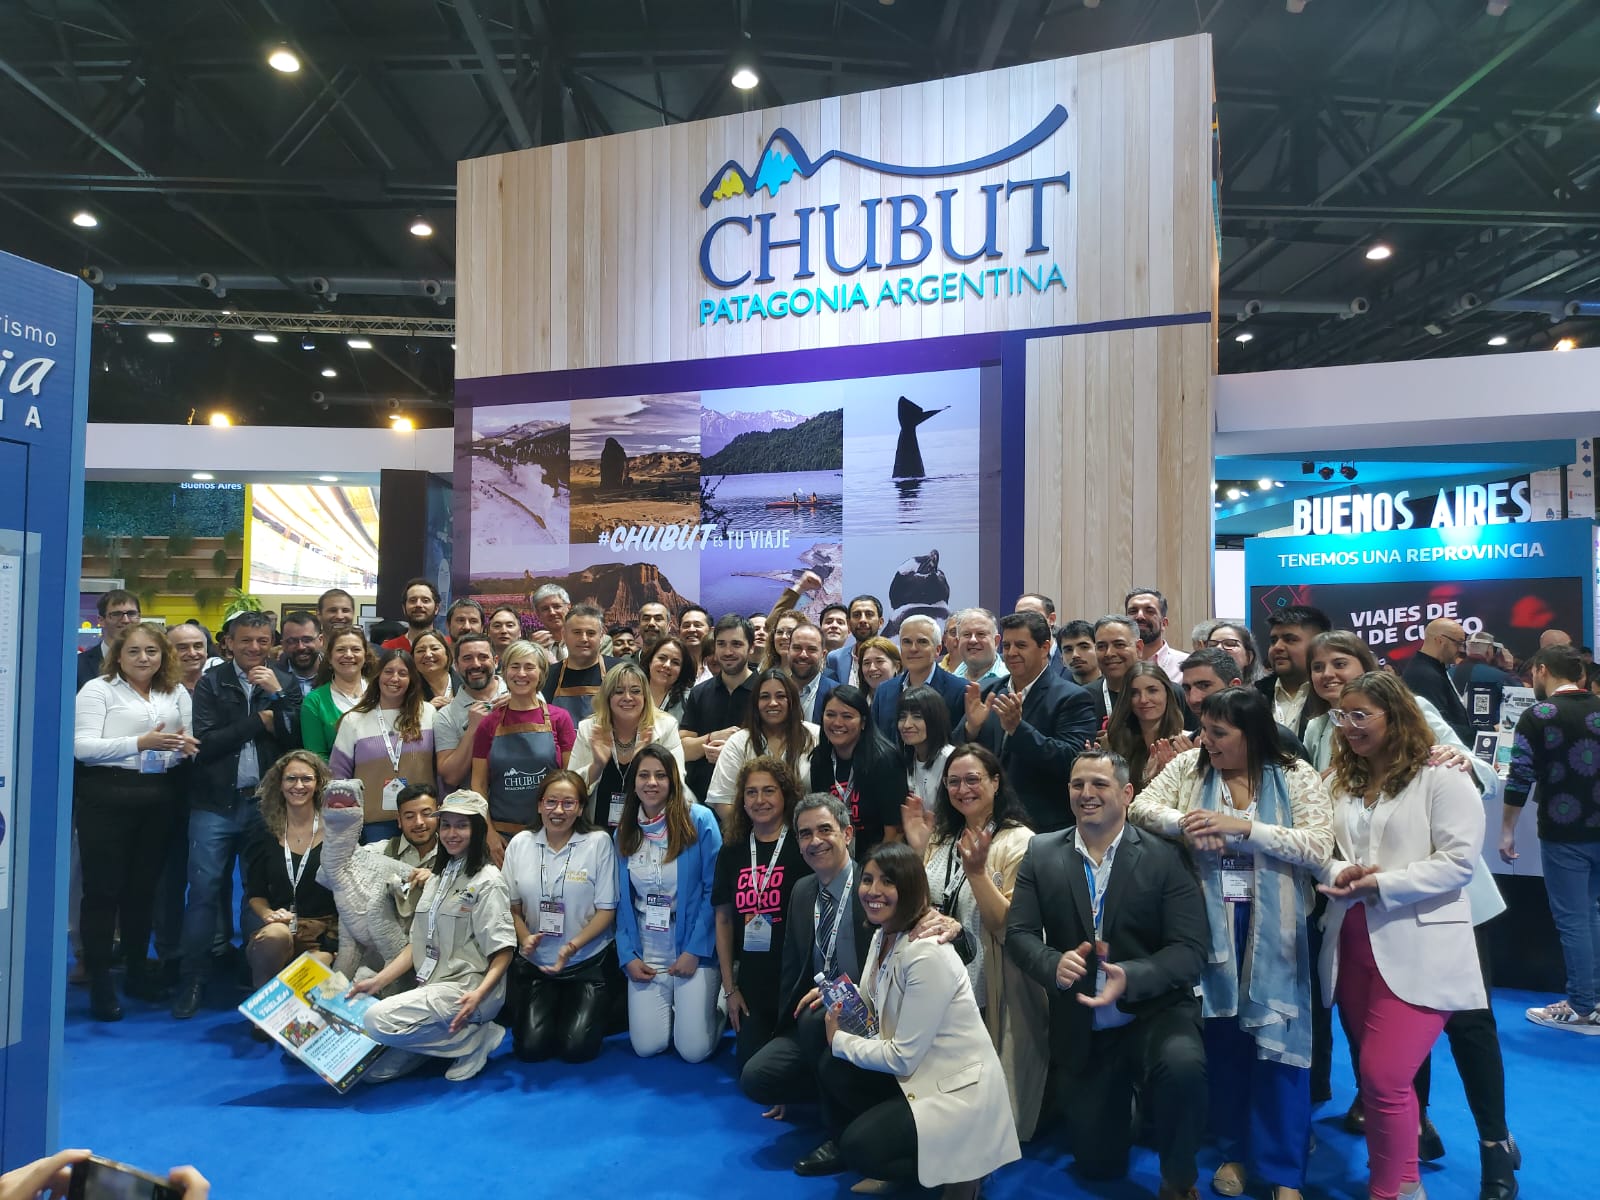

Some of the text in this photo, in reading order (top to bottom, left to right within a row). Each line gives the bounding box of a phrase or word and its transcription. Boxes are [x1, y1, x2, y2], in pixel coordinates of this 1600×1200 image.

[700, 171, 1071, 289] CHUBUT
[700, 263, 1068, 325] PATAGONIA ARGENTINA
[0, 315, 57, 347] ismo
[1294, 480, 1533, 537] BUENOS AIRES
[597, 523, 790, 553] #CHUBUT ES TU VIAJE
[1278, 542, 1545, 568] TENEMOS UNA REPROVINCIA
[1351, 601, 1458, 628] VIAJES DE
[1368, 627, 1398, 645] DE
[735, 889, 781, 909] DORO
